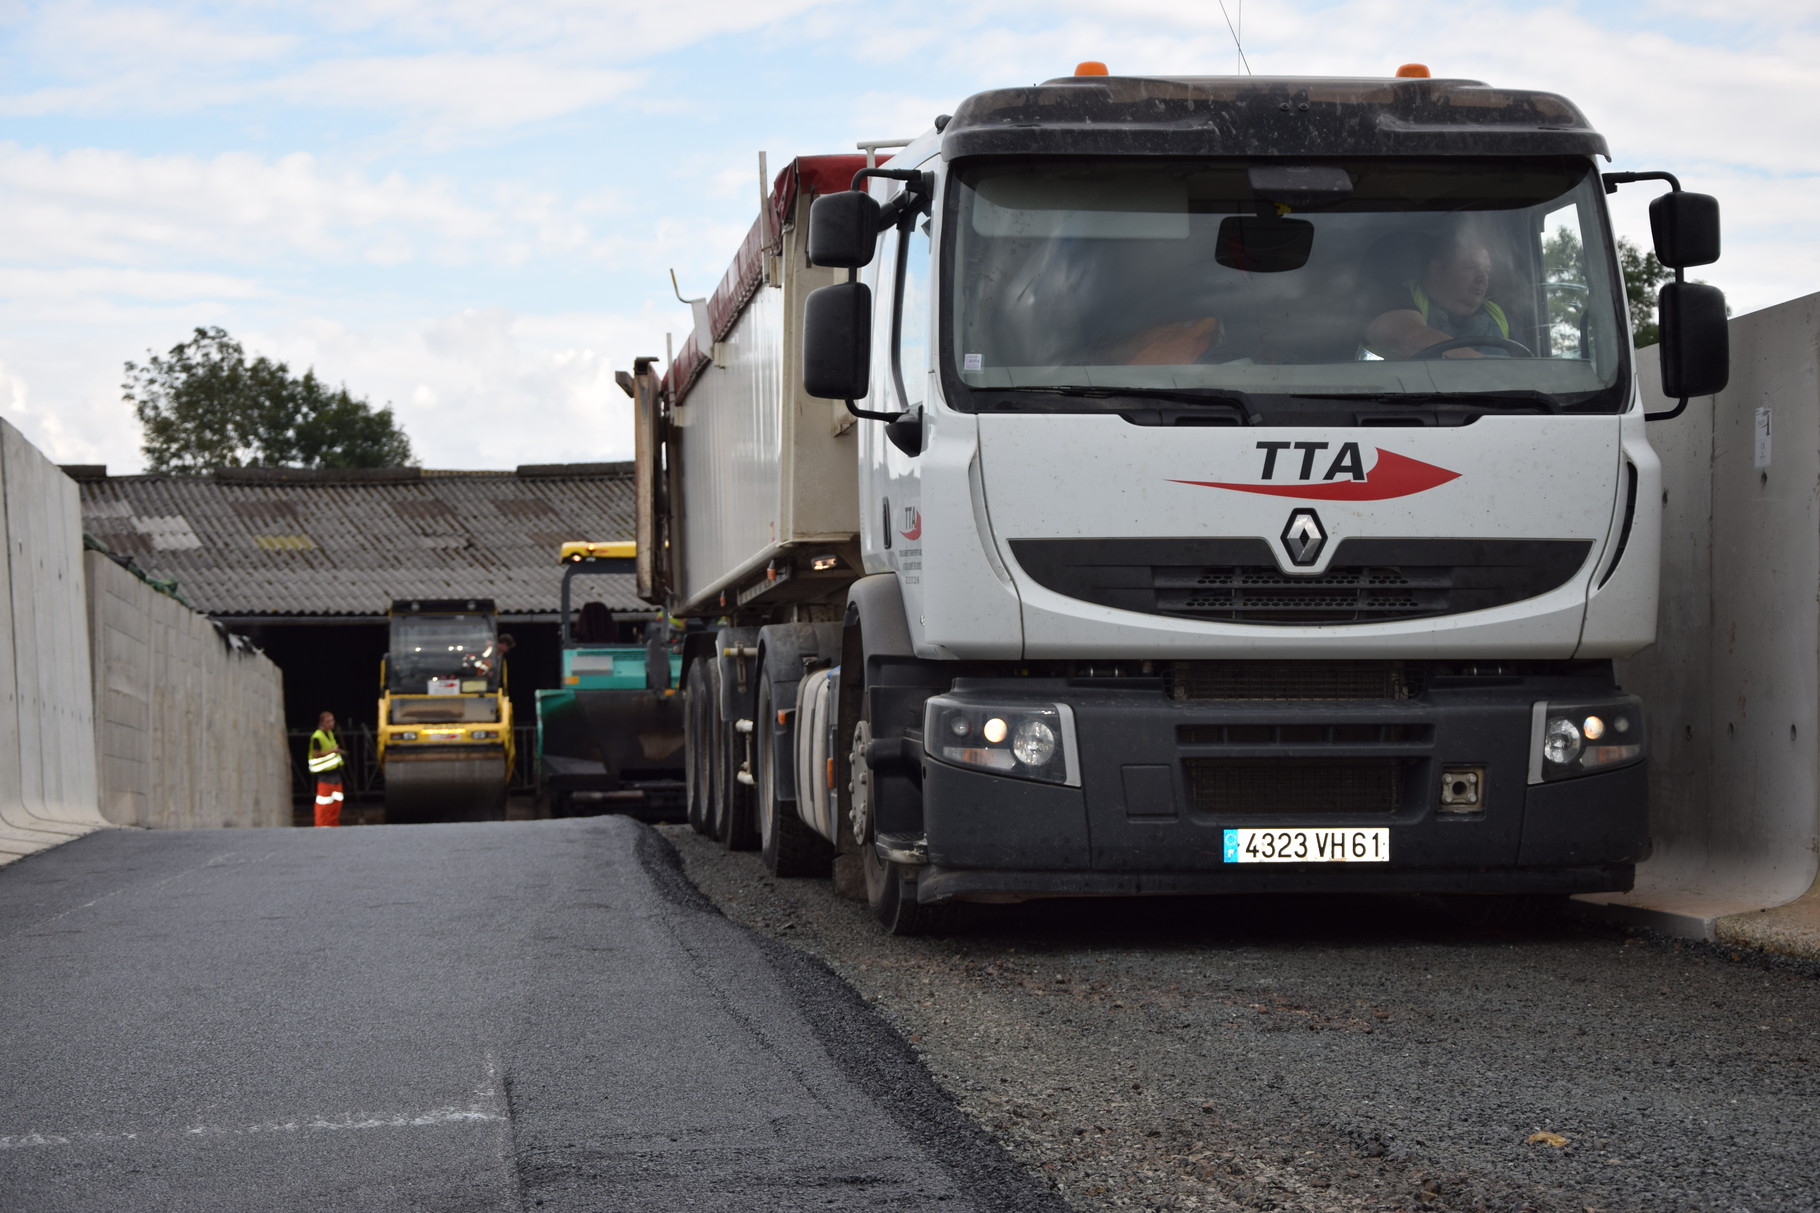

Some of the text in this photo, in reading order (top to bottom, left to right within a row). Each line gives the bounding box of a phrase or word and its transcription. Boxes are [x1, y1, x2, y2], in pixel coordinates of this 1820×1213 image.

[1256, 441, 1366, 481] TTA
[905, 506, 917, 530] TTA
[1245, 832, 1379, 859] 4323 VH 61
